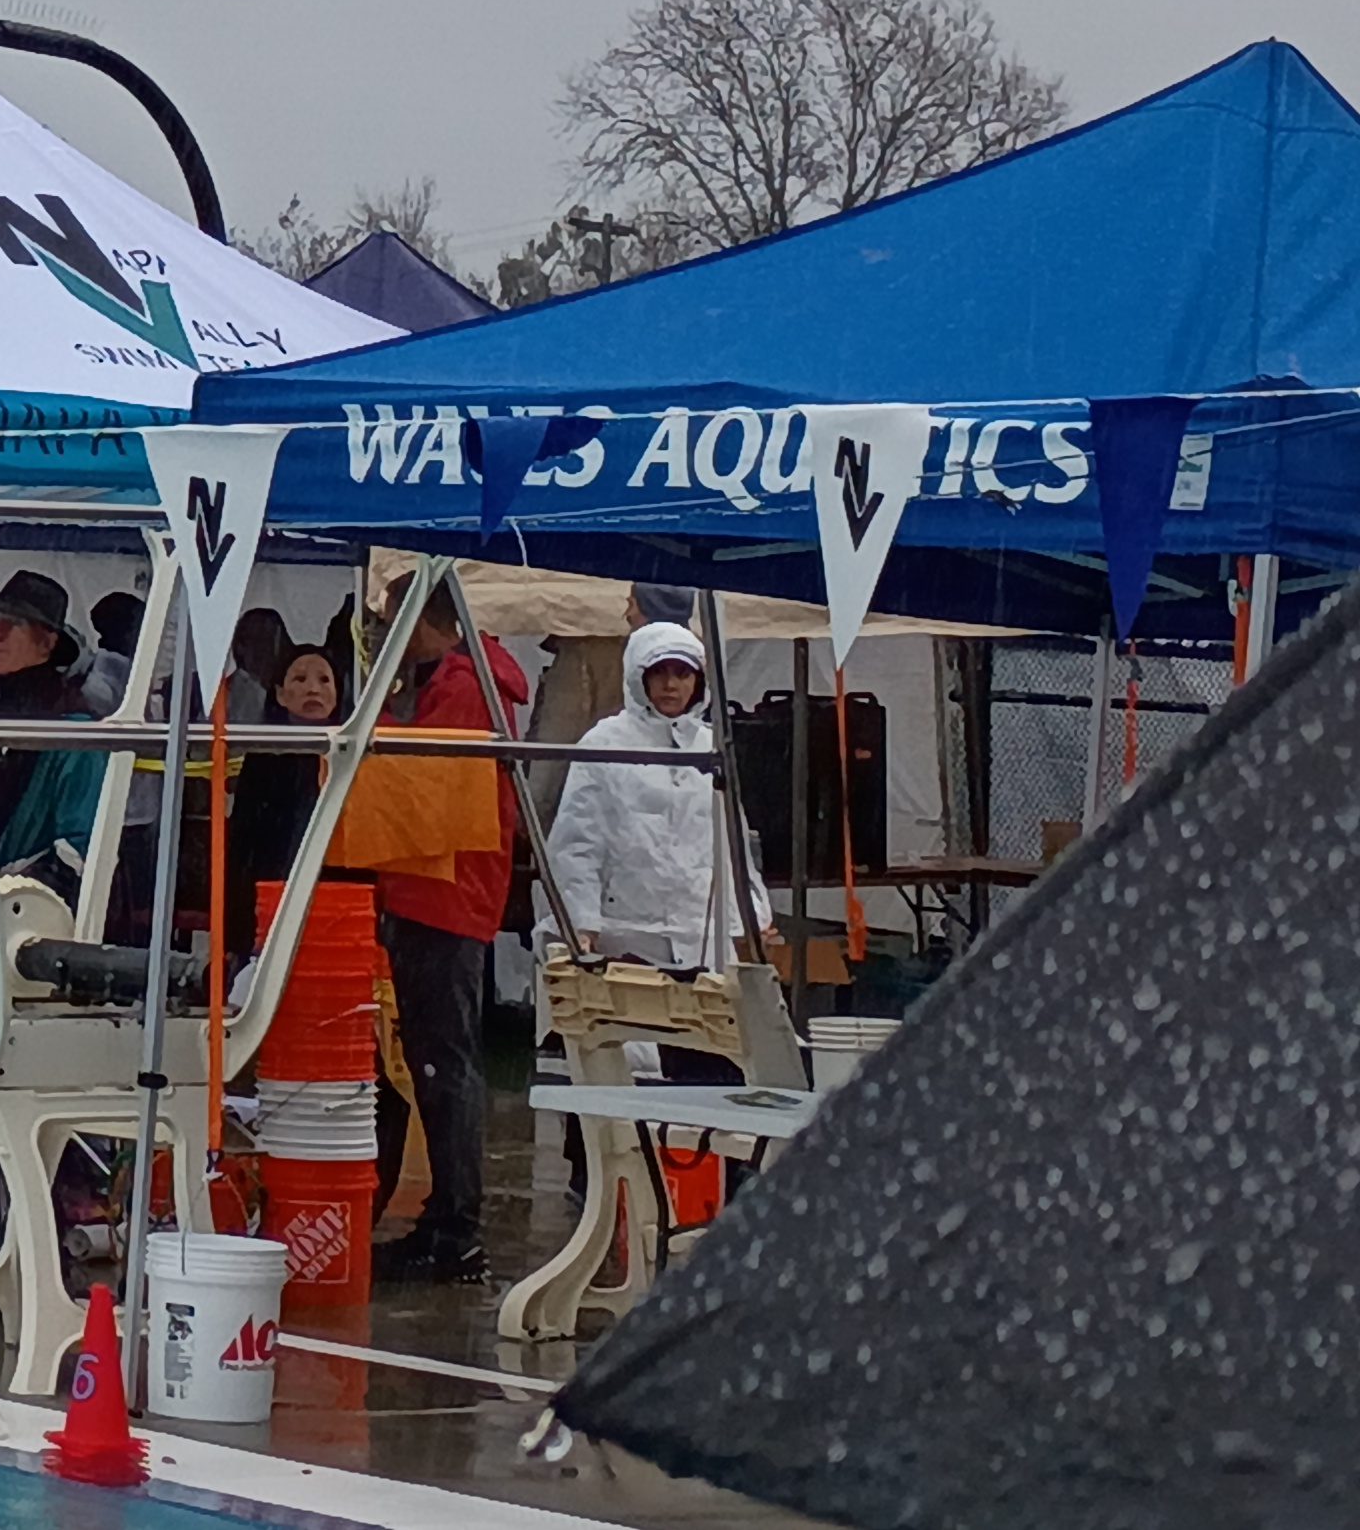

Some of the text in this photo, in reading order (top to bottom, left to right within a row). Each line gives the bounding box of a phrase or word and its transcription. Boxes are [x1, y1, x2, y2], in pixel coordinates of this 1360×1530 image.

[625, 405, 1094, 512] AQUICS
[218, 1312, 279, 1363] AC
[71, 1353, 100, 1401] 6
